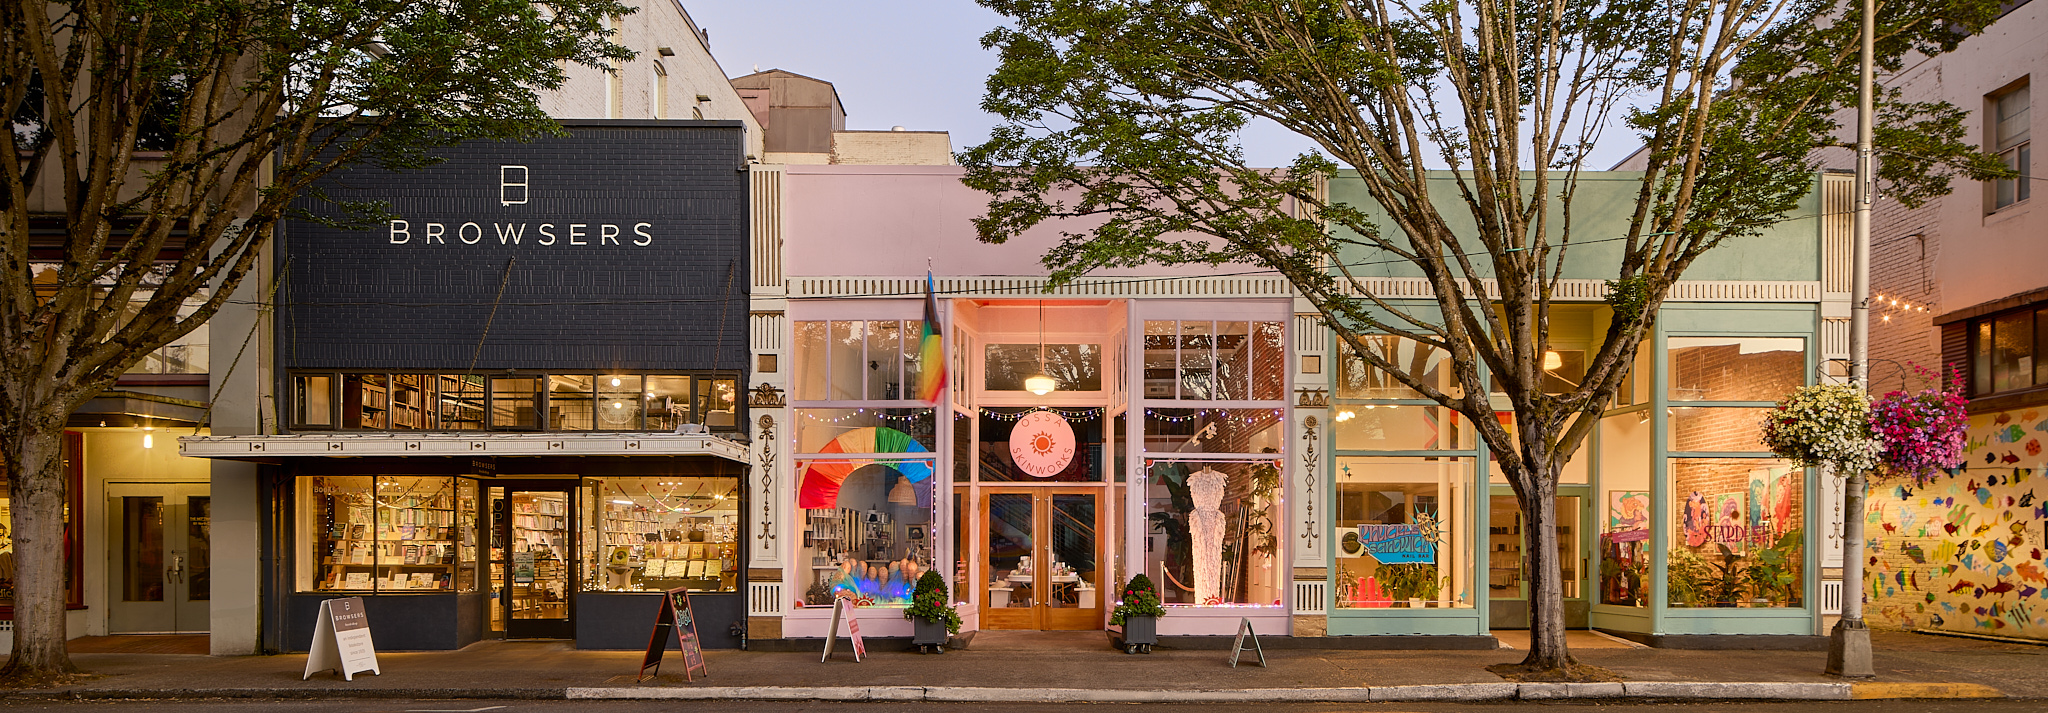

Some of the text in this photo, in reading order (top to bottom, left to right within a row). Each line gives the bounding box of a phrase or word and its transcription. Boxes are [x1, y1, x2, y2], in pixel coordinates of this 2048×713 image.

[390, 219, 652, 247] BROWSERS
[1021, 413, 1062, 428] OSSA
[1012, 447, 1073, 475] SKINWORKS
[1134, 455, 1144, 487] 109
[492, 500, 504, 549] OPEN
[1703, 525, 1766, 543] STARDUST
[335, 611, 364, 622] BROWSERS
